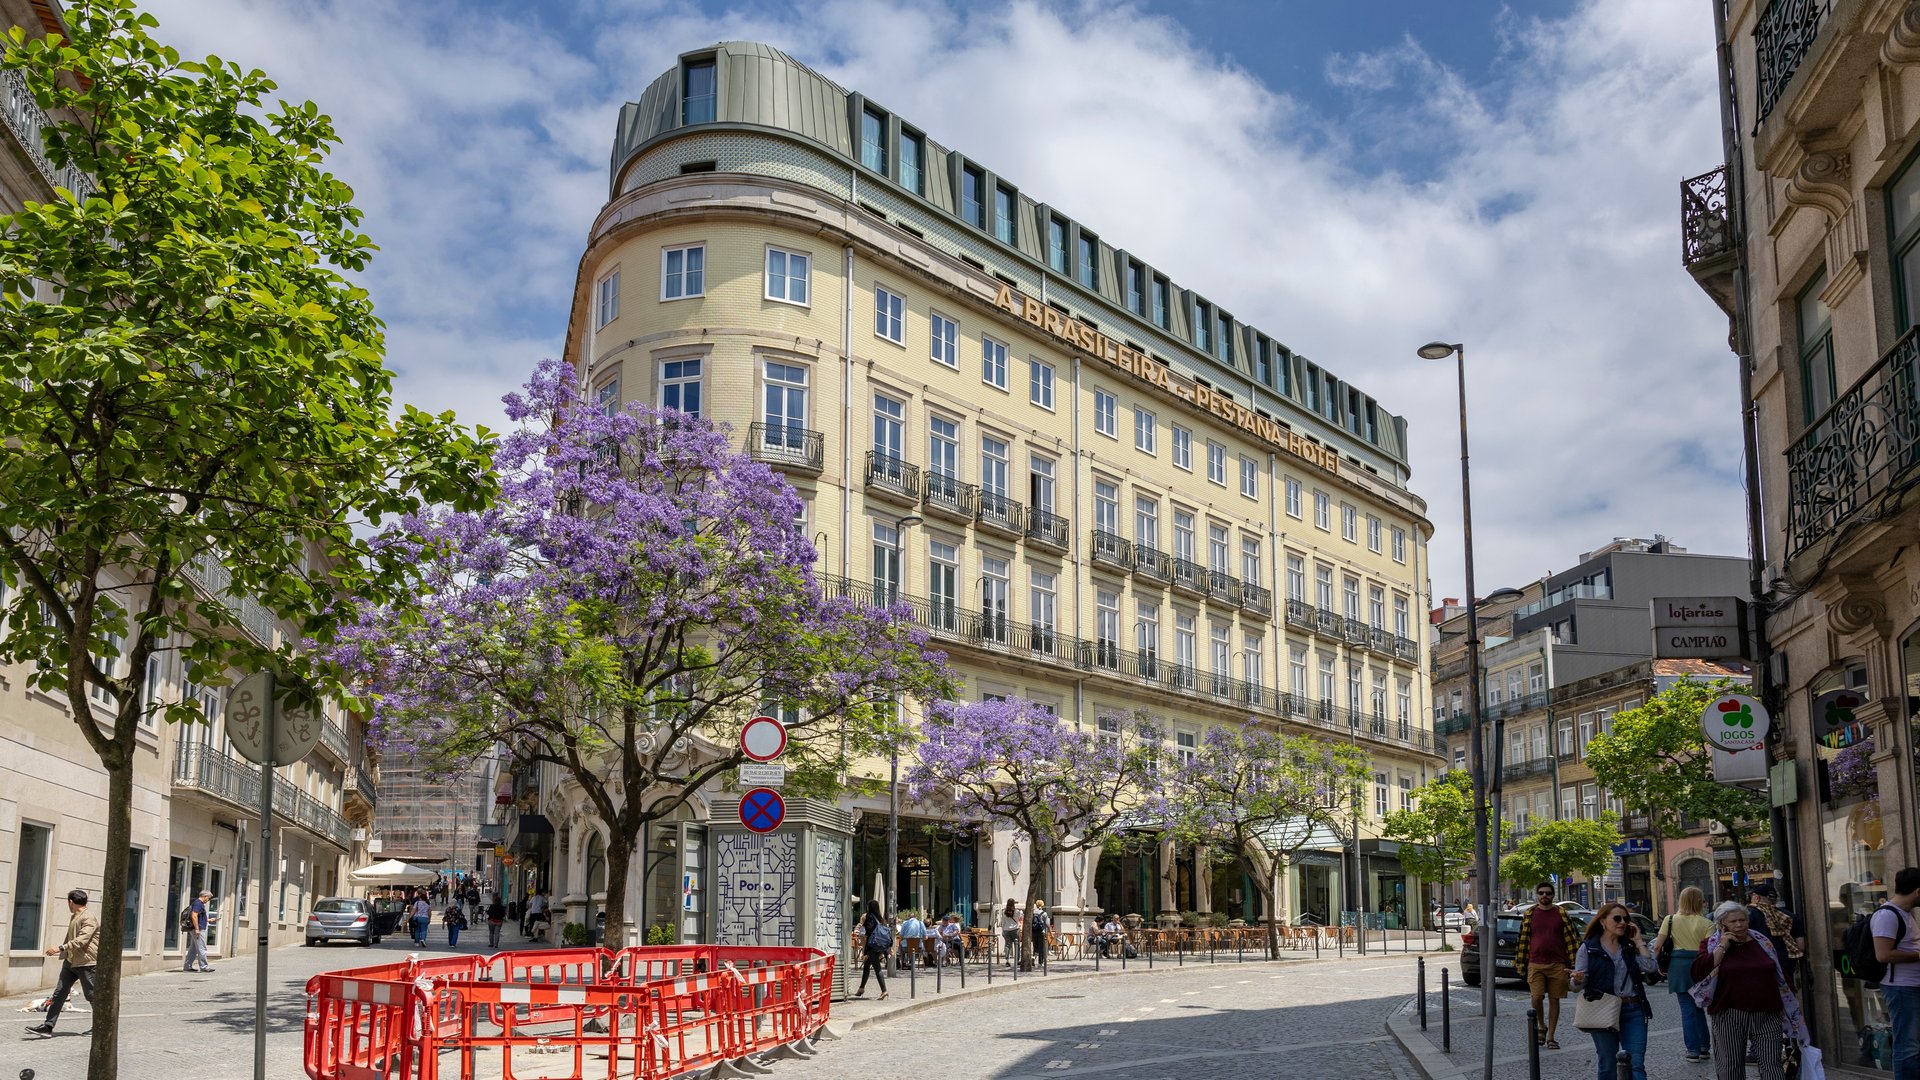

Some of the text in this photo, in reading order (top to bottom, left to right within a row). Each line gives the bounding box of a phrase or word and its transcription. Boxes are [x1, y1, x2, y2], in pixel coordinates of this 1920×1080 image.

[994, 284, 1015, 313] A
[1023, 297, 1172, 391] BRASILEIRA
[1195, 384, 1281, 446] PESTANA
[1287, 431, 1340, 475] HOTEL
[1668, 603, 1723, 621] lotarias
[1671, 635, 1727, 648] CAMPIÃO
[1720, 730, 1755, 742] JOGOS
[739, 880, 775, 891] Poro.
